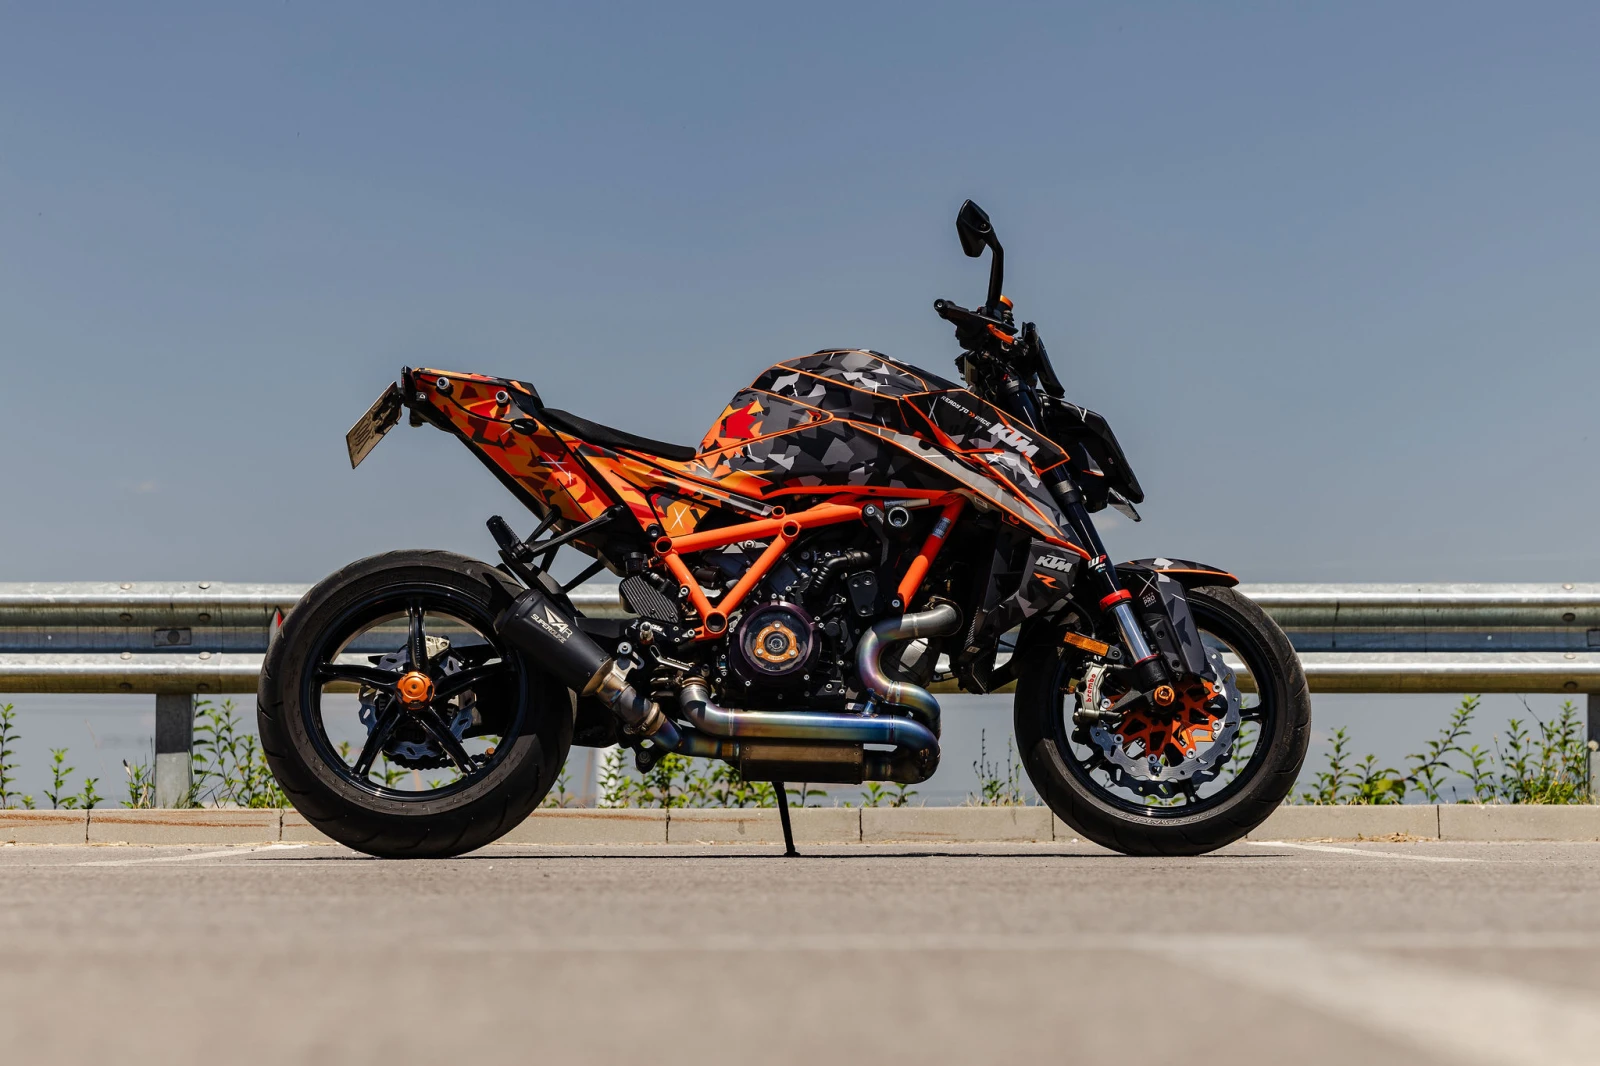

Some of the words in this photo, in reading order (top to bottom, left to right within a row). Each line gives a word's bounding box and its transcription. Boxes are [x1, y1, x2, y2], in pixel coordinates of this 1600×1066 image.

[941, 396, 961, 409] READY
[959, 406, 969, 414] TO
[987, 422, 1040, 458] KTM
[1035, 554, 1073, 573] KTM
[1087, 554, 1107, 569] WP
[1086, 673, 1096, 703] brembo
